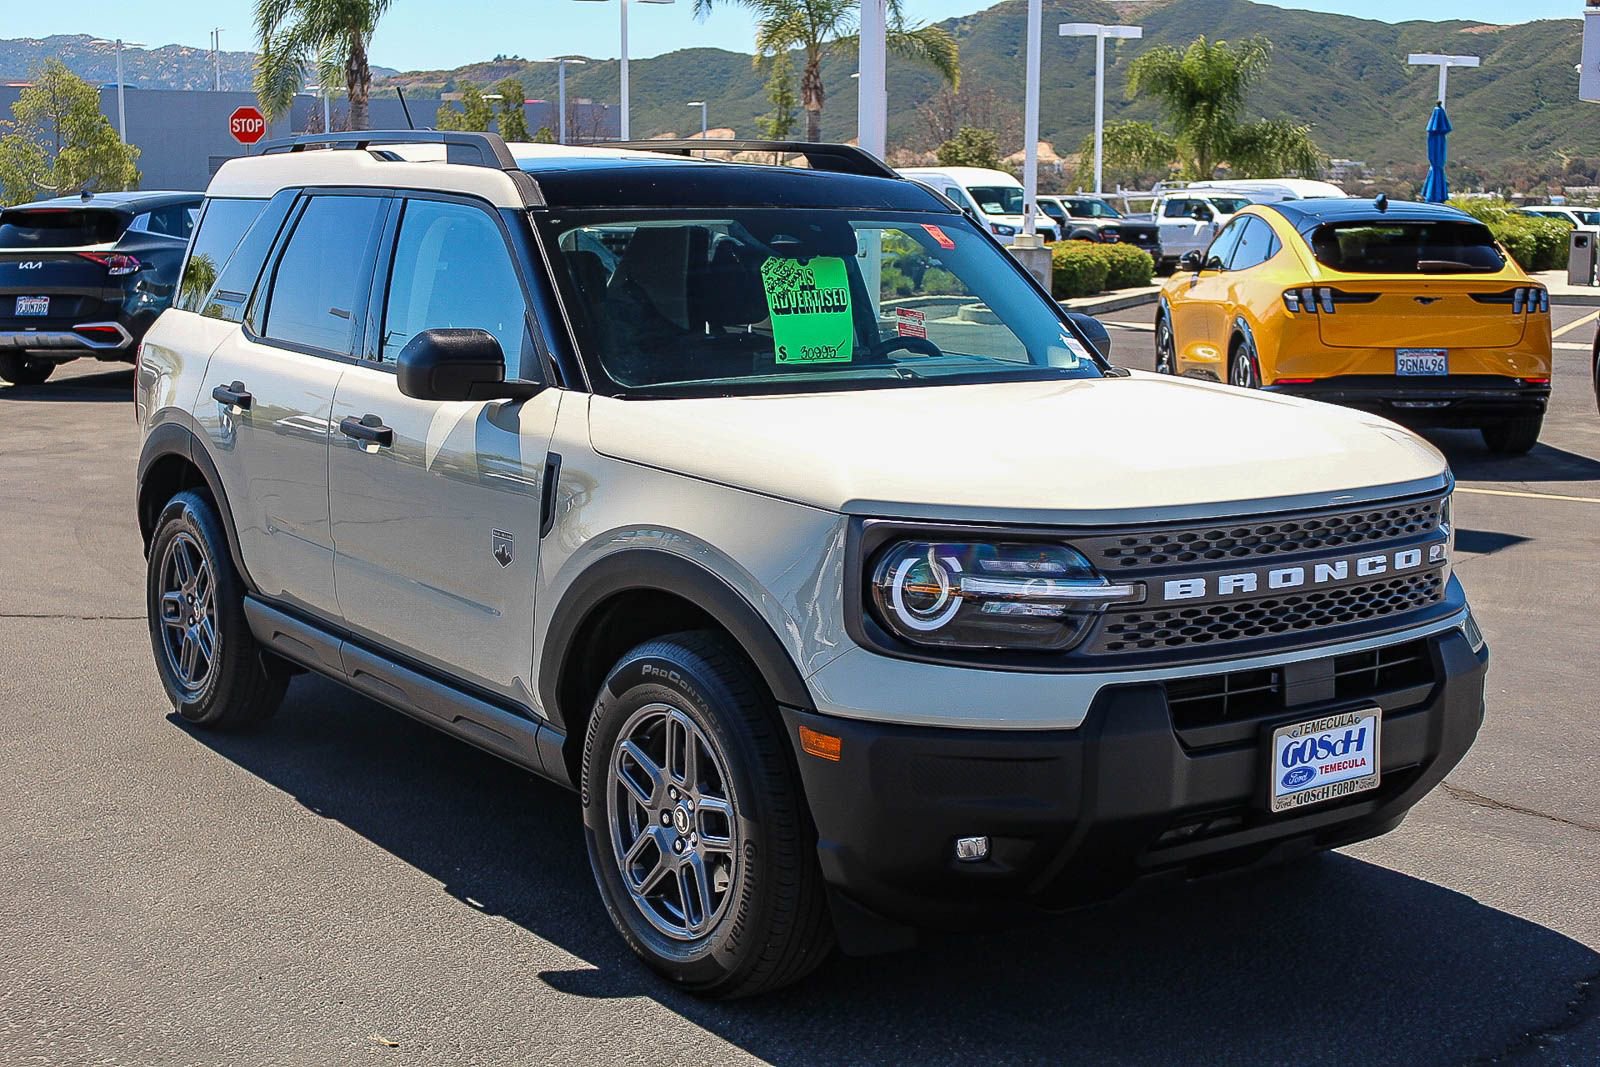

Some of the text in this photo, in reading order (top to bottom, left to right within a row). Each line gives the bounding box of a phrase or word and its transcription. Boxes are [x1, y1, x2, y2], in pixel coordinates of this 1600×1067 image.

[232, 118, 263, 132] STOP
[19, 261, 43, 269] KIA
[799, 268, 815, 287] AS
[771, 288, 848, 313] ADVERTISED
[778, 345, 787, 361] $
[1399, 358, 1444, 371] 9GNA496
[1164, 549, 1421, 600] BRONCO
[1299, 714, 1354, 735] TEMECULA
[1319, 758, 1366, 775] TEMECULA
[1332, 781, 1355, 797] FORD
